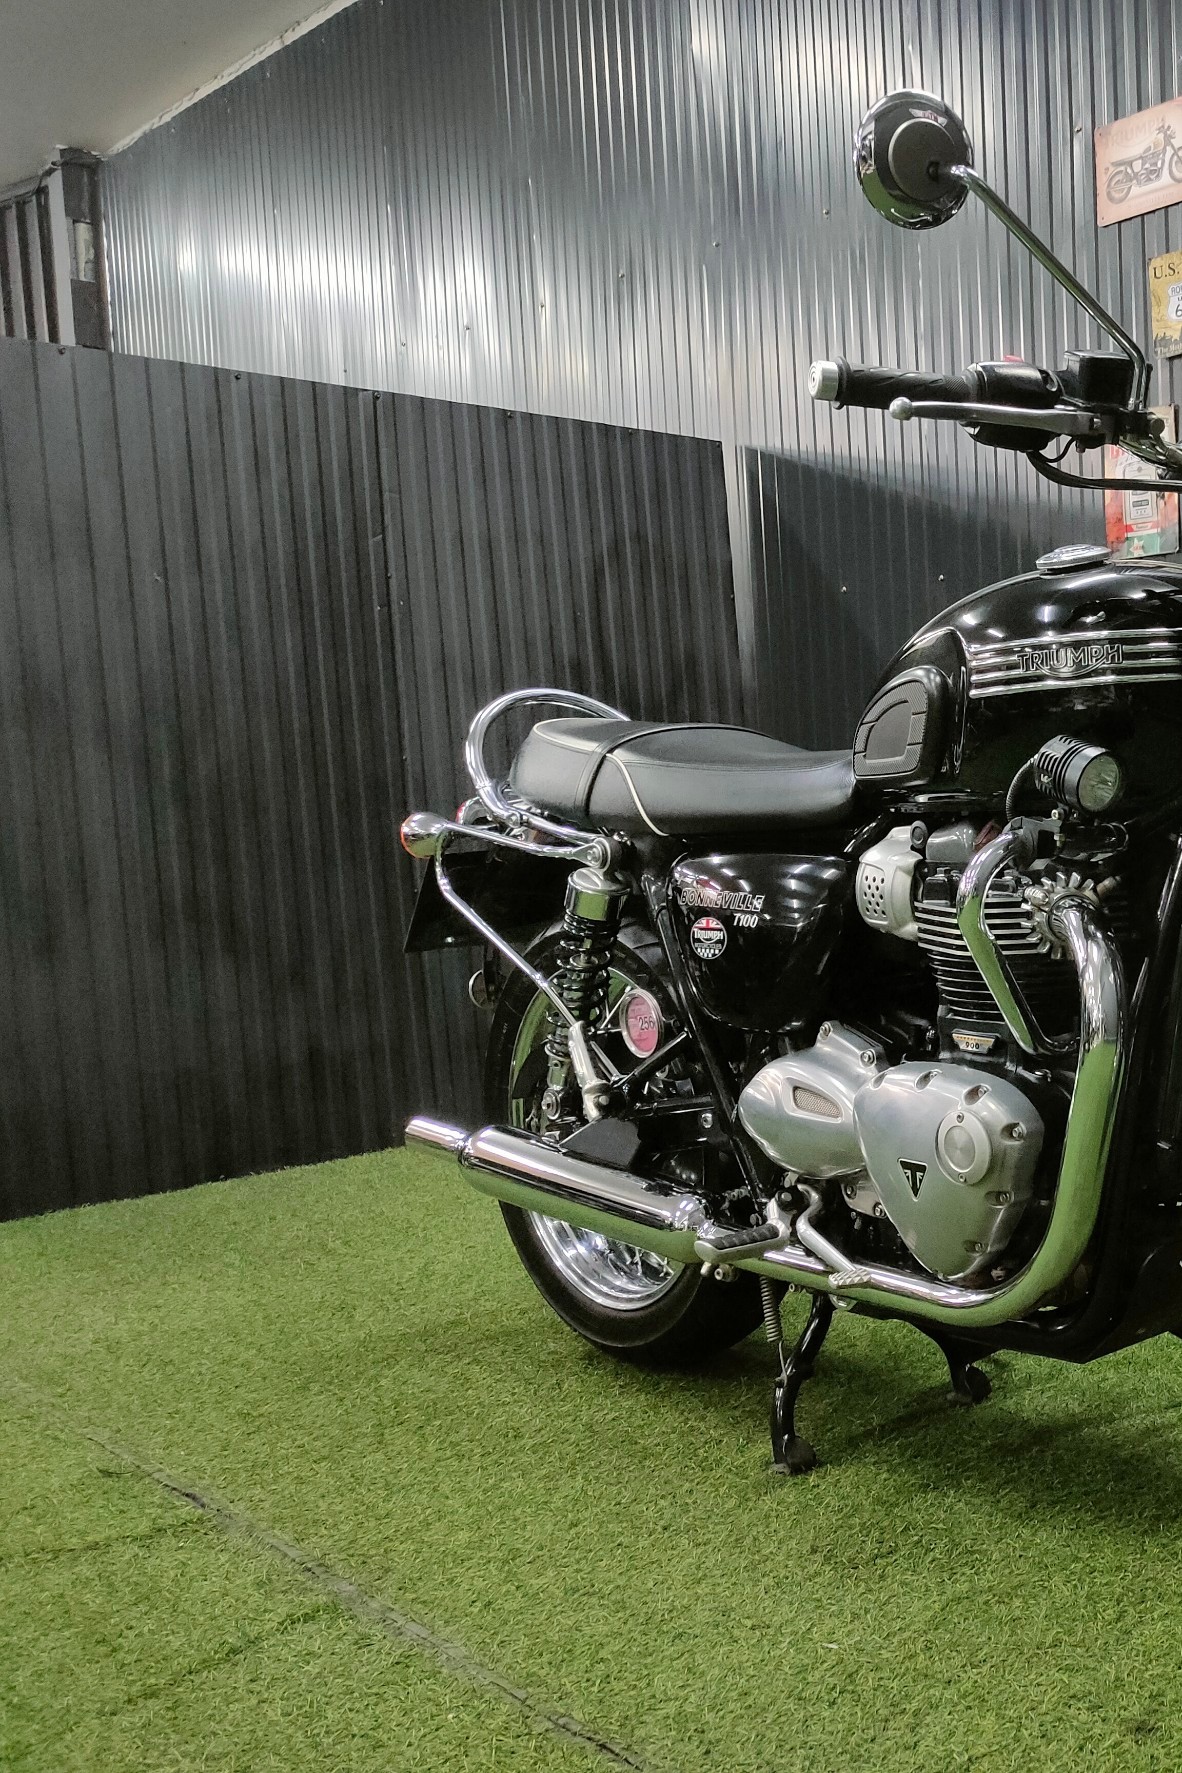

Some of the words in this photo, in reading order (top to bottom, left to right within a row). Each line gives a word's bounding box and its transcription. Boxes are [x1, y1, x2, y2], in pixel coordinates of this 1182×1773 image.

[1153, 262, 1180, 280] U.S.
[1016, 644, 1124, 674] TRIUMPH
[680, 887, 765, 912] BONNEVILLE
[733, 913, 759, 928] T100
[693, 928, 724, 941] TRIUMPH
[964, 1040, 981, 1050] 900
